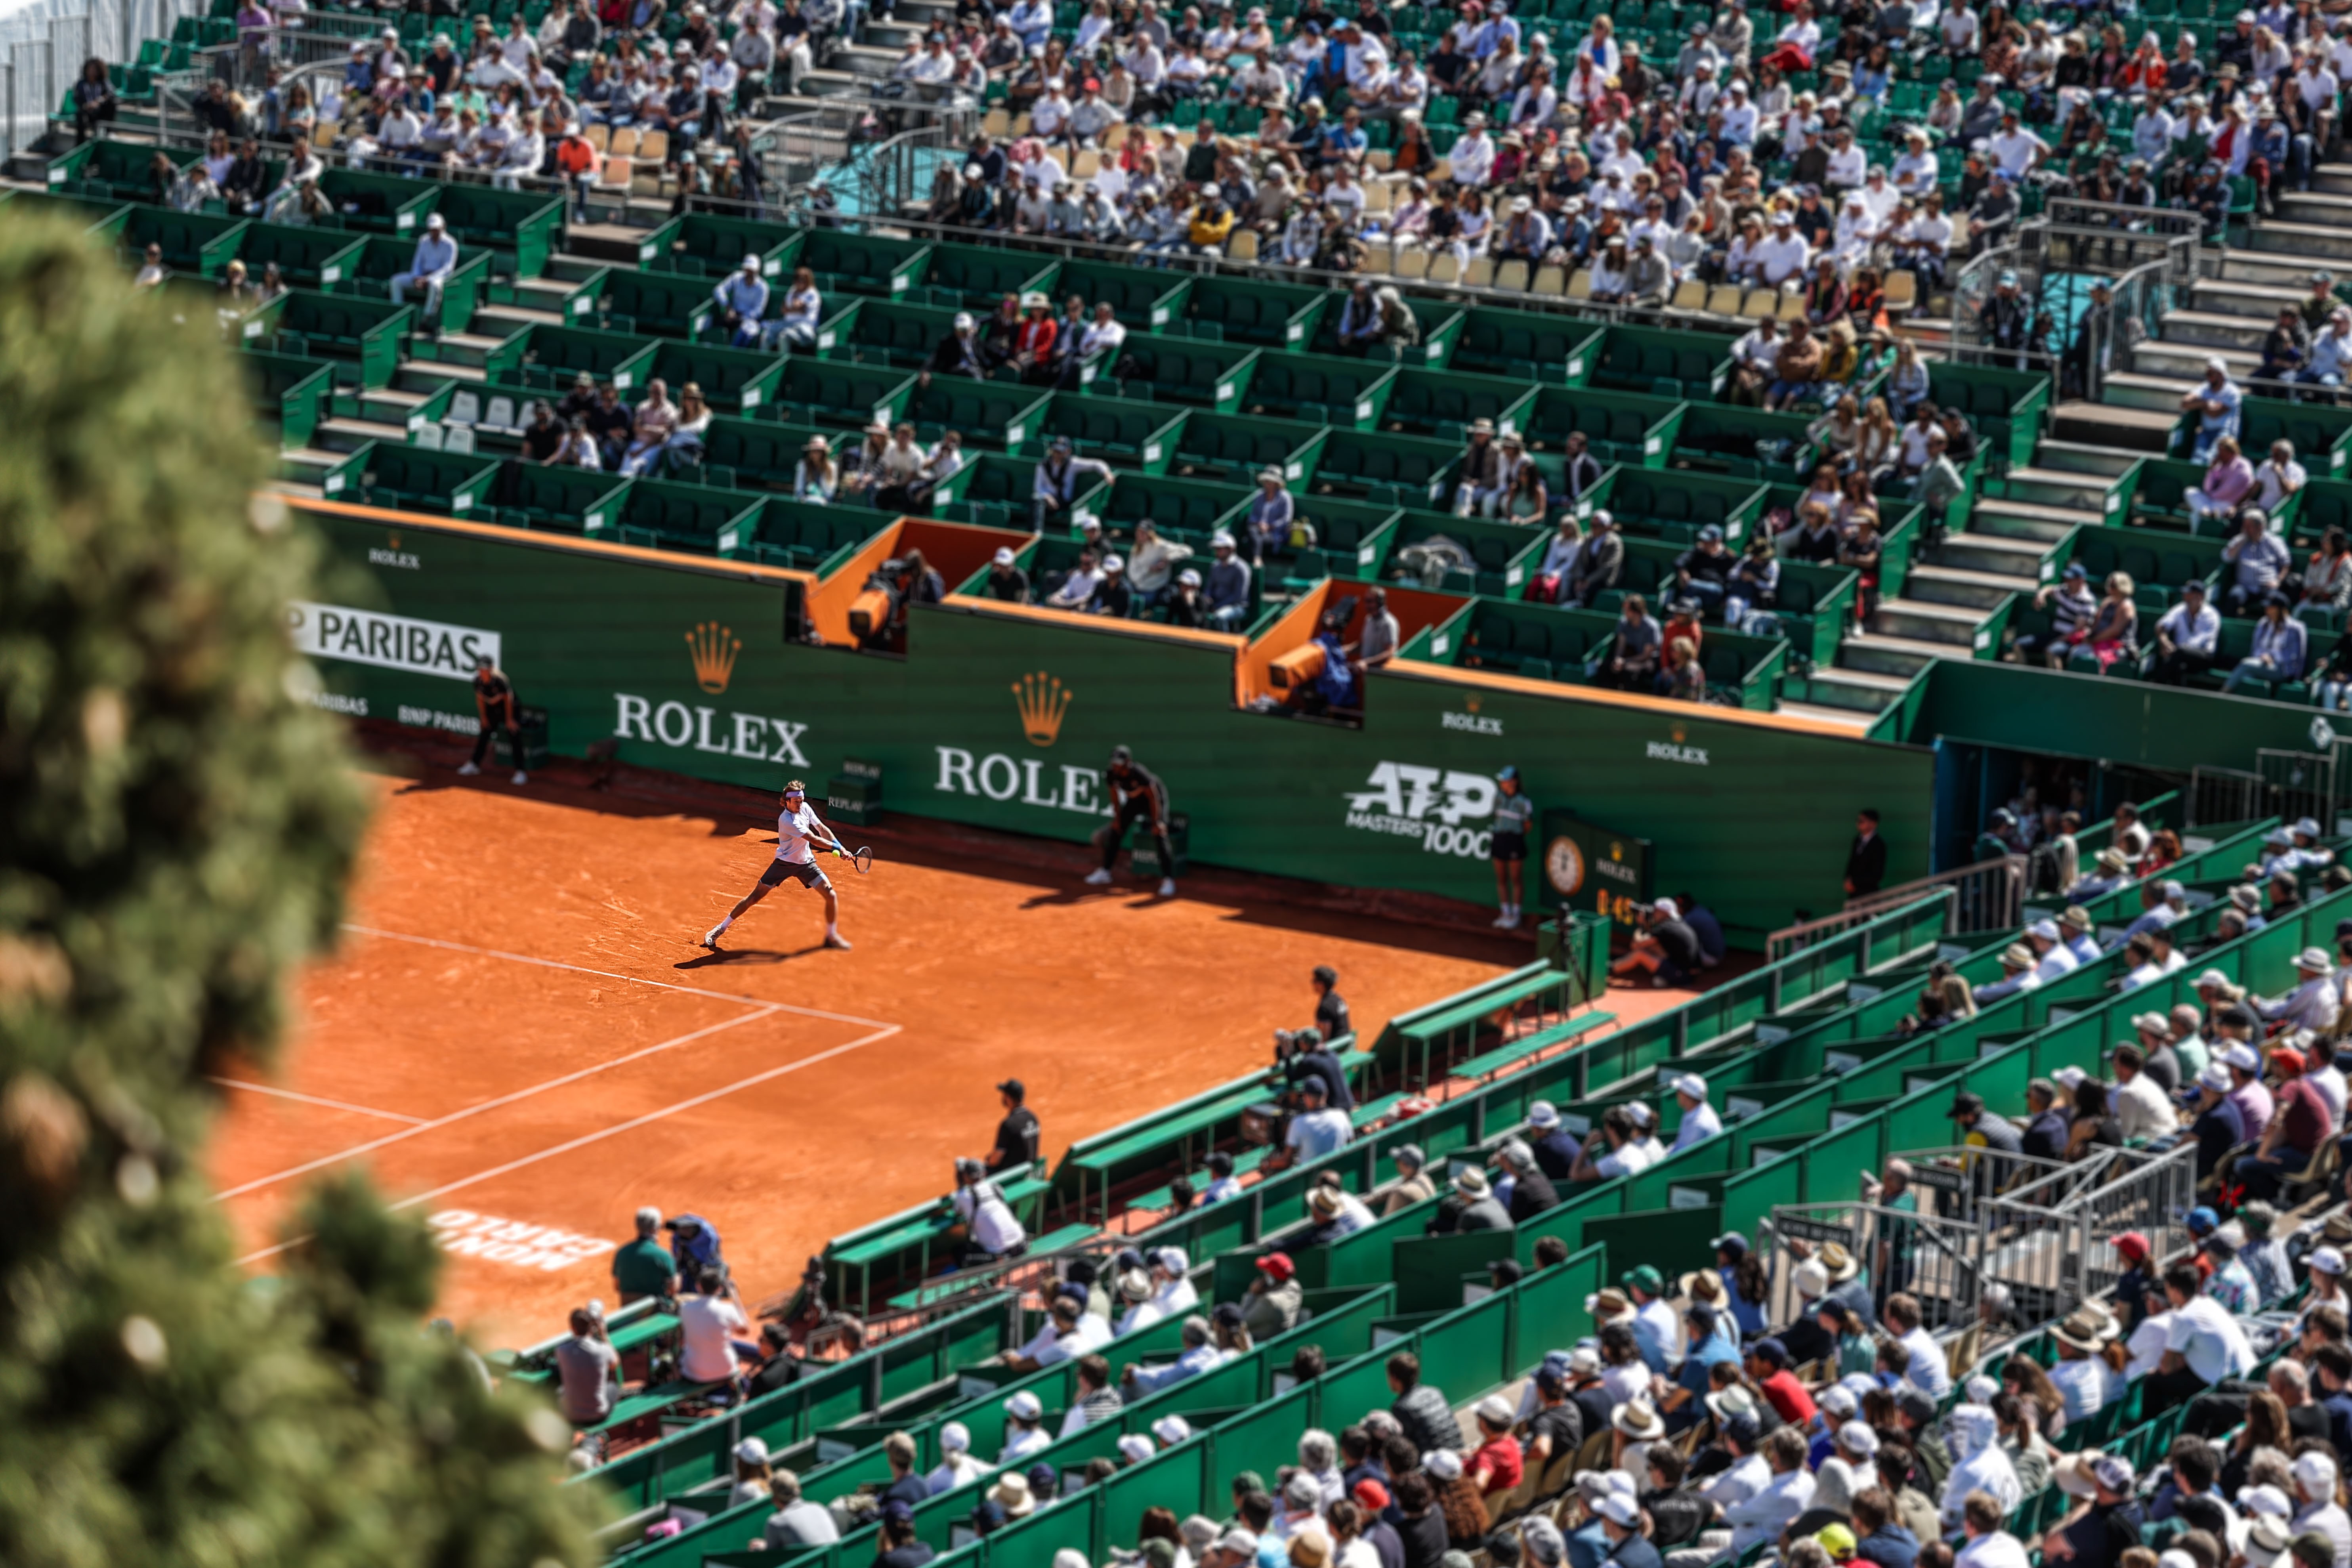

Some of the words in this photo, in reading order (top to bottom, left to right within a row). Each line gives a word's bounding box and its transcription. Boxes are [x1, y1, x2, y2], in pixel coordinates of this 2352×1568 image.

[369, 548, 420, 570] ROLEX
[318, 611, 479, 673] PARIBAS
[306, 690, 369, 716] ARIBAS
[398, 705, 432, 726] BNP
[433, 711, 481, 735] PARIB
[613, 693, 811, 768] ROLEX
[1442, 711, 1503, 735] ROLEX
[1646, 741, 1709, 765] ROLEX
[828, 796, 864, 813] REPLAY
[1343, 760, 1498, 825] ATP
[1346, 810, 1424, 838] MASTERS
